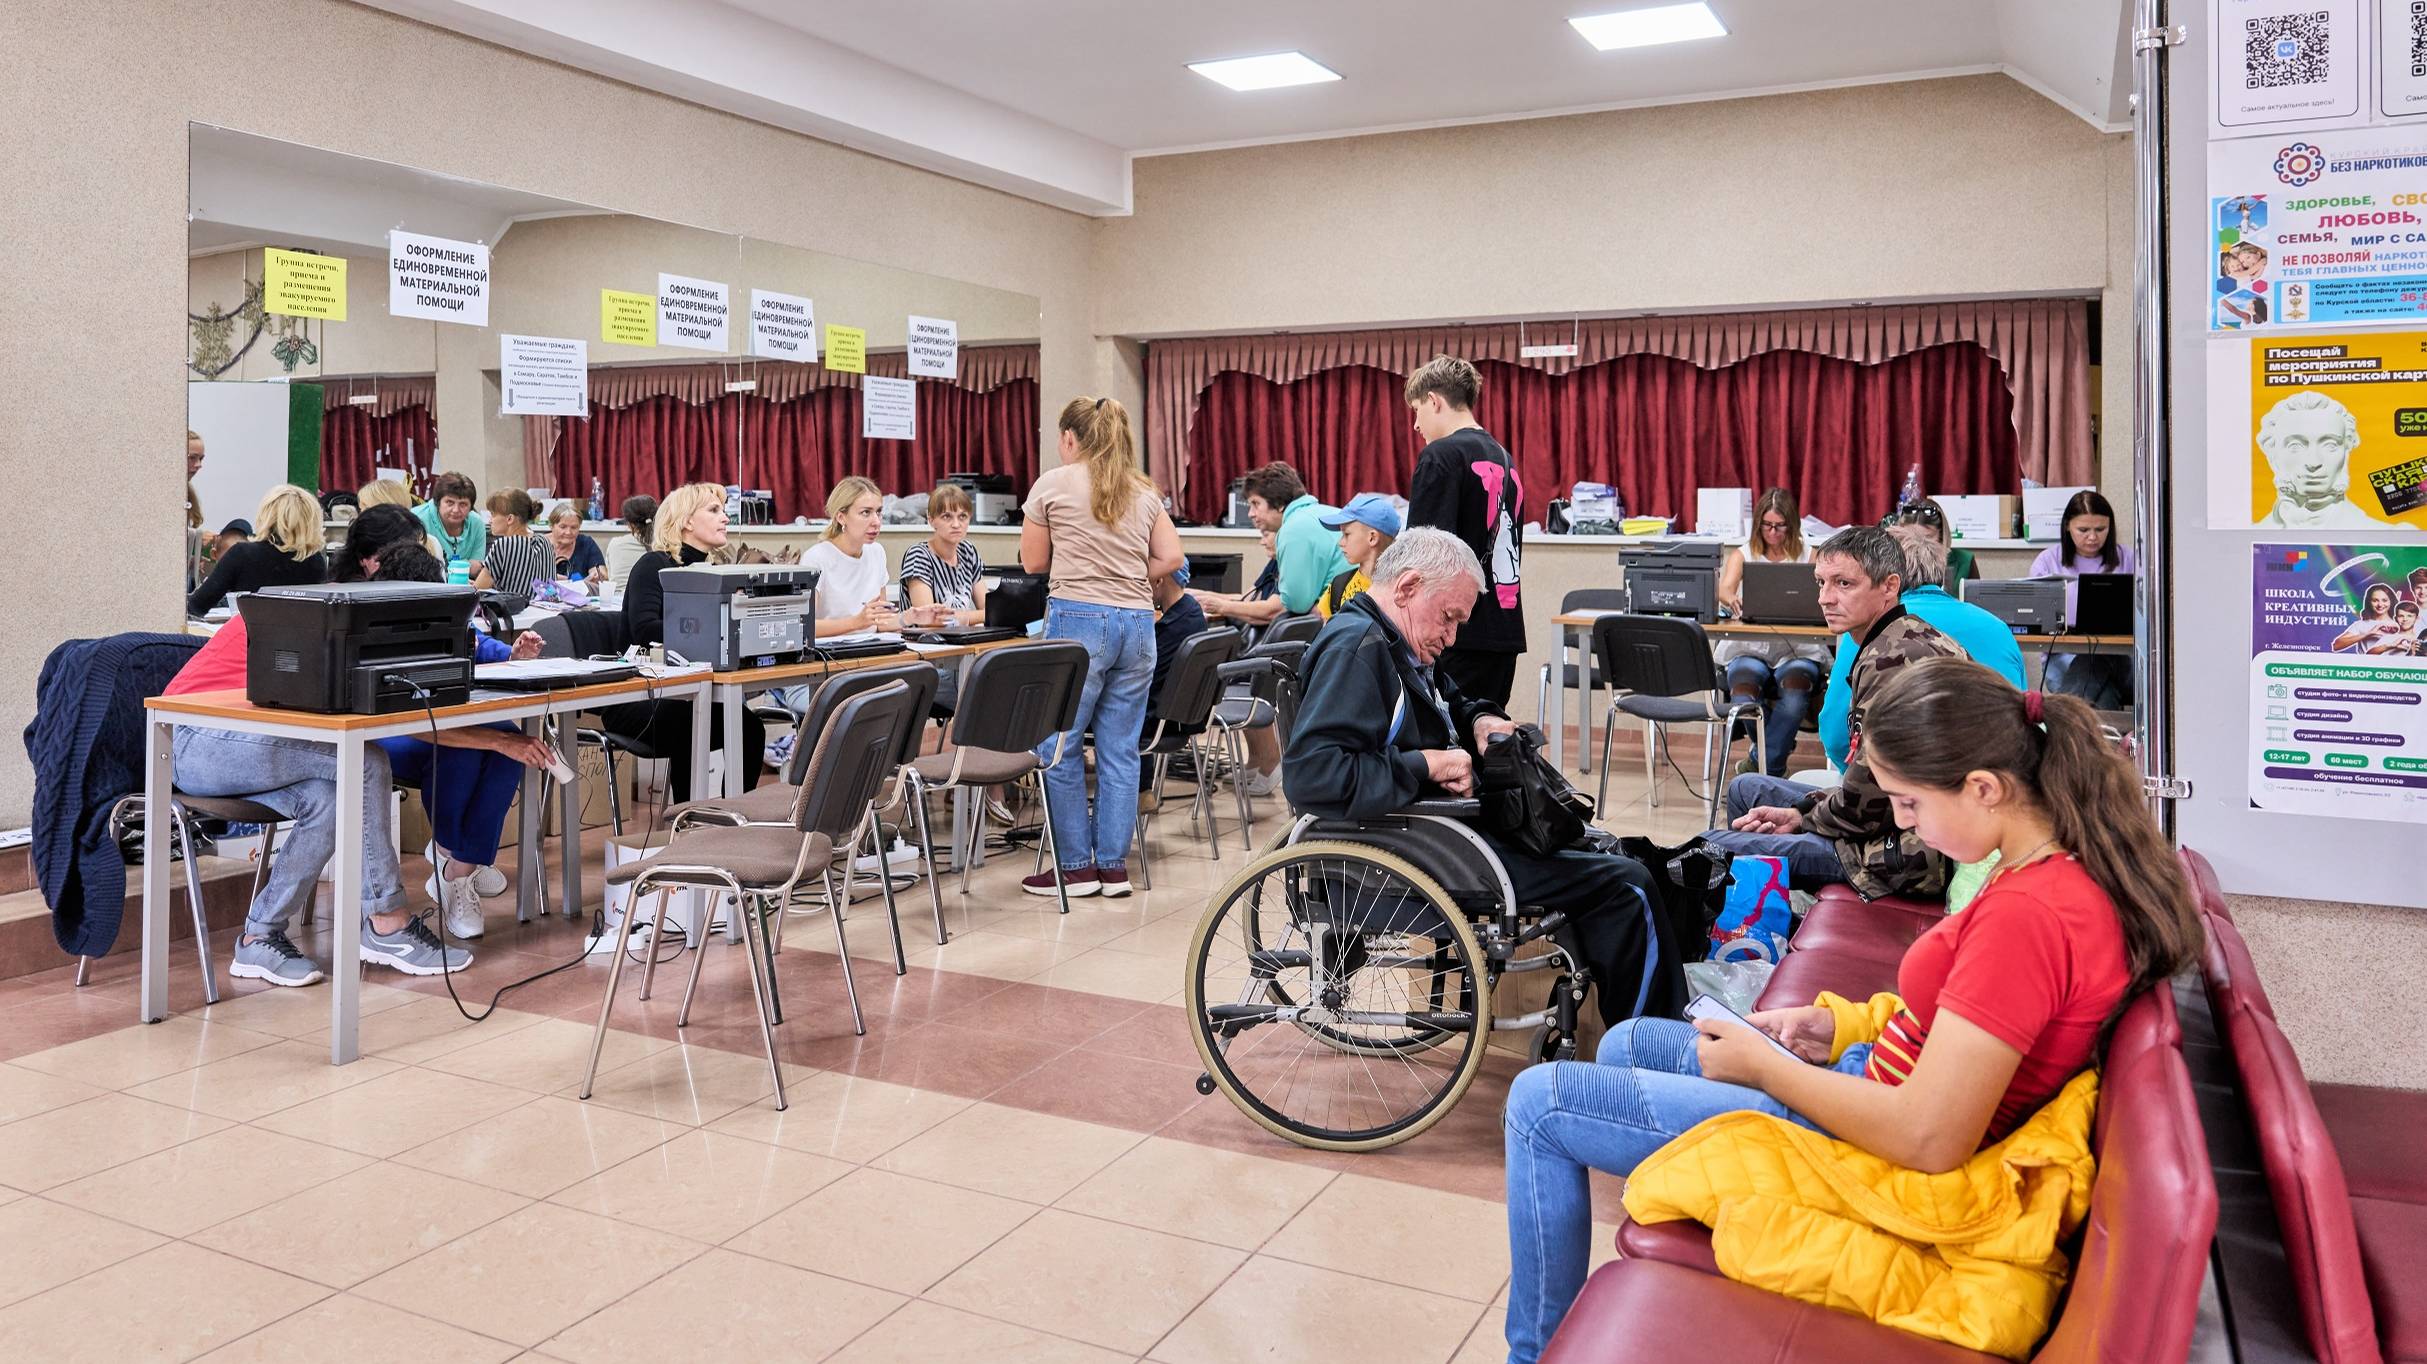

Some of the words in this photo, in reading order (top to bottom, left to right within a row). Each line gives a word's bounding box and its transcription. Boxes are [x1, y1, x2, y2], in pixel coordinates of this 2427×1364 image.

[2330, 160, 2352, 173] БЕЗ
[2285, 195, 2376, 211] ЗДОРОВЬЕ,
[2317, 210, 2422, 229] ЛЮБОВЬ,
[2277, 232, 2338, 244] СЕМЬЯ,
[2351, 235, 2385, 246] МИР
[2390, 234, 2401, 244] С
[406, 243, 475, 265] ОФОРМЛЕНИЕ
[2282, 255, 2299, 266] НЕ
[2302, 247, 2371, 265] ПОЗВОЛЯЙ
[2374, 251, 2427, 262] НАРКОТ
[393, 258, 487, 282] ЕДИНОВРЕМЕННОЙ
[2281, 267, 2312, 277] ТЕБЯ
[2316, 263, 2377, 275] ГЛАВНЫХ
[2380, 262, 2427, 273] ЦЕННО
[400, 275, 480, 297] МАТЕРИАЛЬНОЙ
[669, 284, 719, 301] ОФОРМЛЕНИЕ
[416, 294, 464, 312] ПОМОЩИ
[660, 296, 728, 316] ЕДИНОВРЕМЕННОЙ
[761, 299, 804, 314] ОФОРМЛЕНИЕ
[665, 311, 723, 328] МАТЕРИАЛЬНОЙ
[677, 326, 711, 341] ПОМОЩИ
[758, 325, 809, 340] МАТЕРИАЛЬНОЙ
[916, 323, 950, 336] ОФОРМЛЕНИЕ
[512, 338, 547, 348] Уважаемые
[768, 338, 798, 352] ПОМОЩИ
[913, 346, 953, 357] МАТЕРИАЛЬНОЙ
[2268, 346, 2341, 359] Посещай
[921, 358, 945, 369] ПОМОЩИ
[2268, 359, 2377, 373] мероприятия
[2268, 374, 2289, 384] по
[2291, 369, 2391, 385] Пушкинской
[2264, 588, 2315, 599] ШКОЛА
[2264, 601, 2357, 613] КРЕАТИВНЫХ
[2264, 614, 2348, 626] ИНДУСТРИЙ
[2271, 642, 2321, 651] Железногорск
[2271, 666, 2334, 677] ОБЪЯВЛЯЕТ
[2336, 669, 2373, 679] НАБОР
[2348, 693, 2417, 702] видеопроизводства
[2321, 712, 2349, 720] дизайна
[2342, 758, 2363, 766] мест
[2313, 772, 2353, 783] обучение
